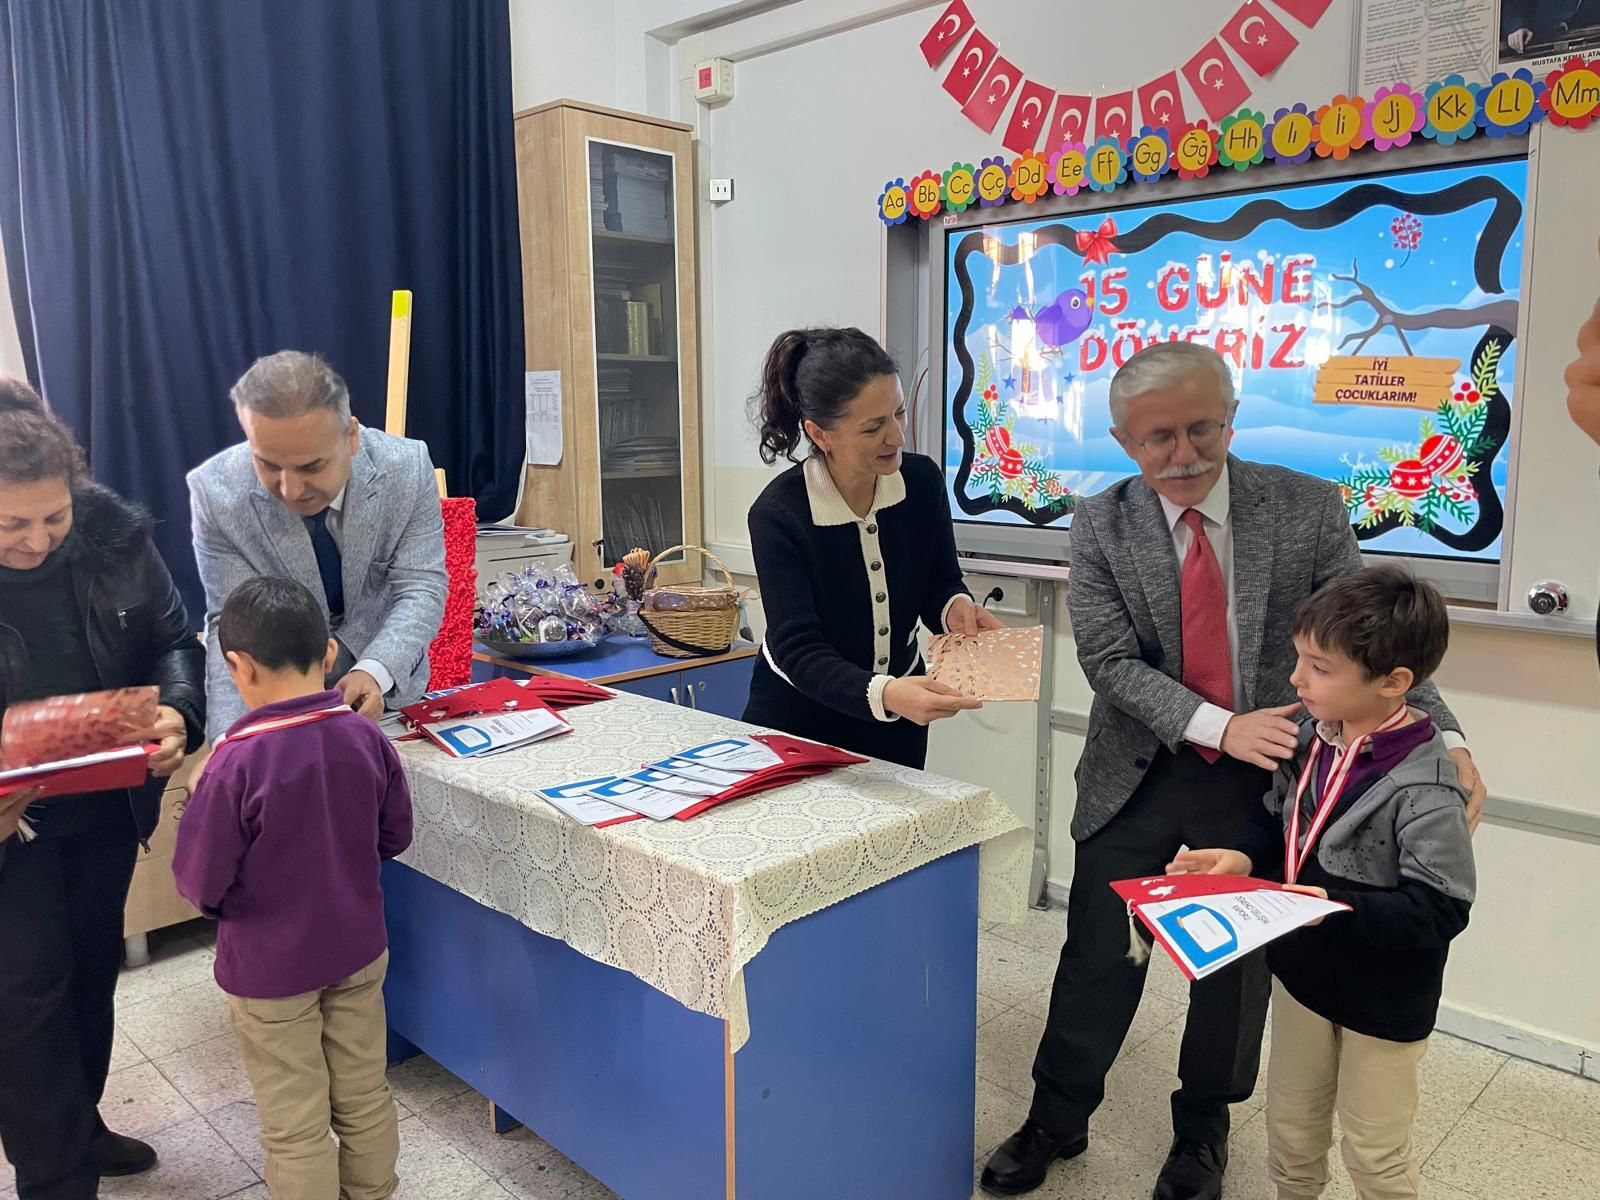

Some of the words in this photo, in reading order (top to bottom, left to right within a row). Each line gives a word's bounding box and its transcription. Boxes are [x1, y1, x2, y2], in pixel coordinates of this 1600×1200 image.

[1531, 56, 1562, 67] MUSTAFA
[884, 194, 904, 213] Aa
[918, 184, 937, 203] Bb
[950, 175, 970, 195] Cc
[981, 171, 1004, 196] Çç
[1017, 163, 1041, 186] Dd
[1060, 157, 1082, 178] Ee
[1096, 151, 1115, 181] Ff
[1134, 142, 1161, 173] Gg
[1182, 131, 1209, 166] Ğğ
[1228, 126, 1259, 150] Hh
[1382, 99, 1400, 134] Jj
[1436, 93, 1468, 121] Kk
[1497, 86, 1521, 114] Ll
[1555, 78, 1600, 107] Mm
[1080, 267, 1129, 316] 15
[1156, 251, 1317, 312] GÜNE
[1079, 317, 1308, 373] DÖRİZ
[1372, 356, 1389, 371] İYİ
[1354, 372, 1406, 387] TATİLLER
[1335, 388, 1417, 403] ÇOCUKLARIM!
